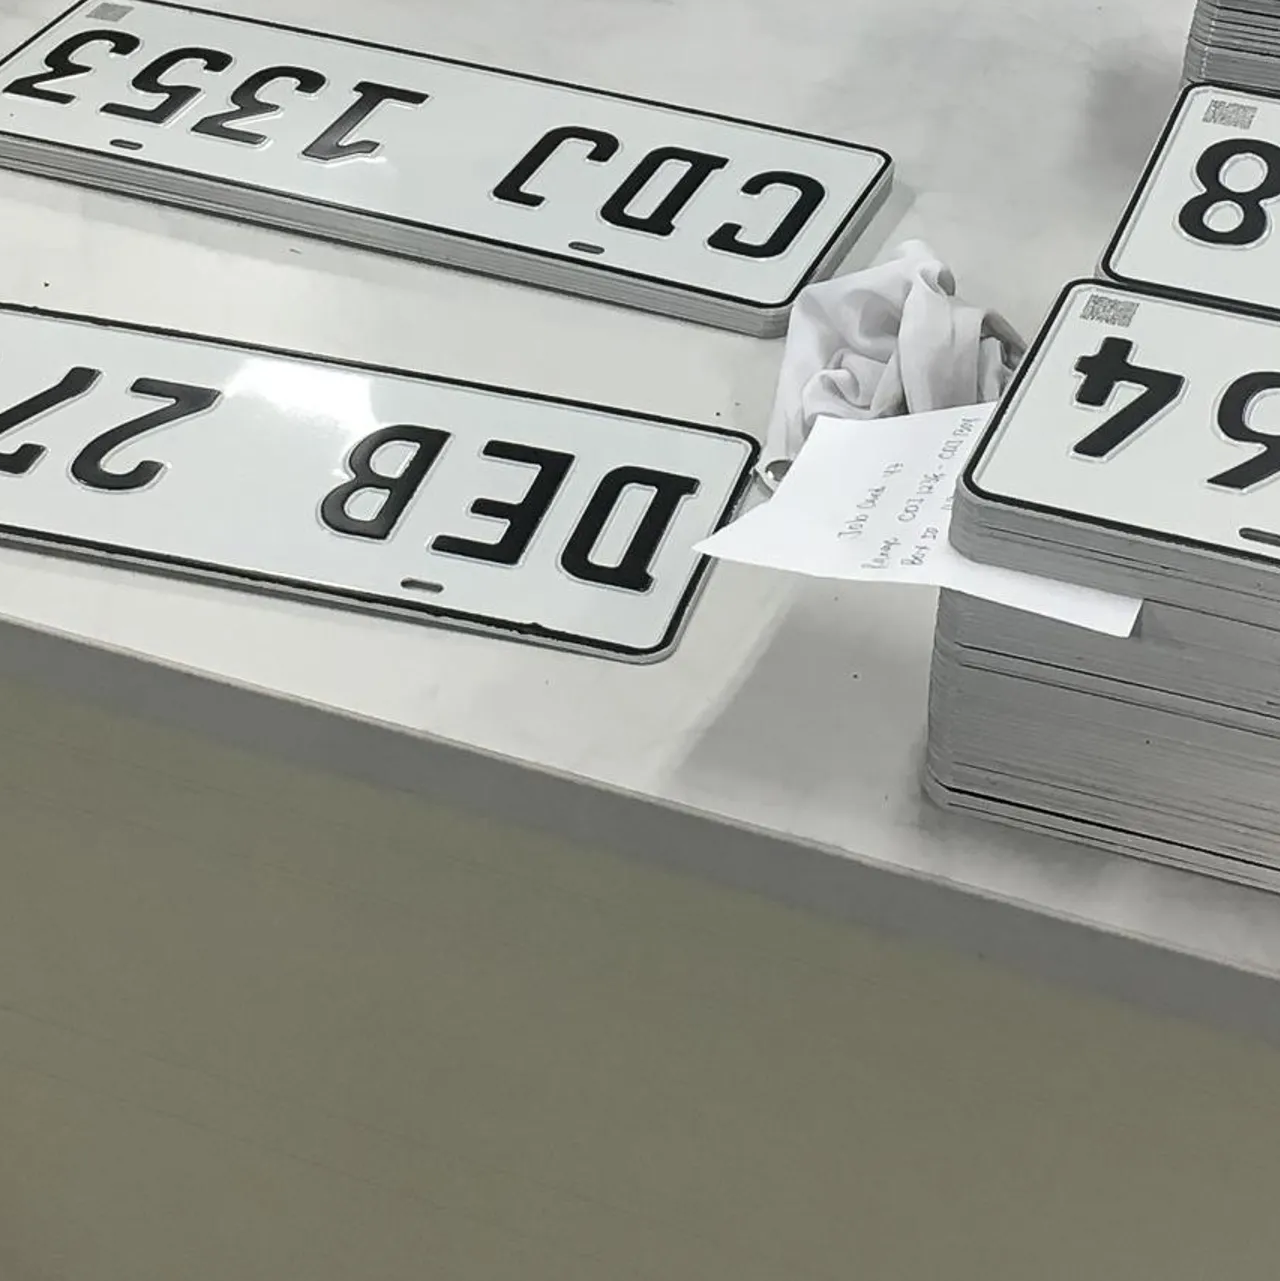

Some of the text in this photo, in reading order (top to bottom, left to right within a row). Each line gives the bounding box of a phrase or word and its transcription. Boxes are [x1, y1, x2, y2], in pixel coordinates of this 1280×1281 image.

[1, 30, 827, 259] CDJ 1353
[321, 424, 701, 592] DEB
